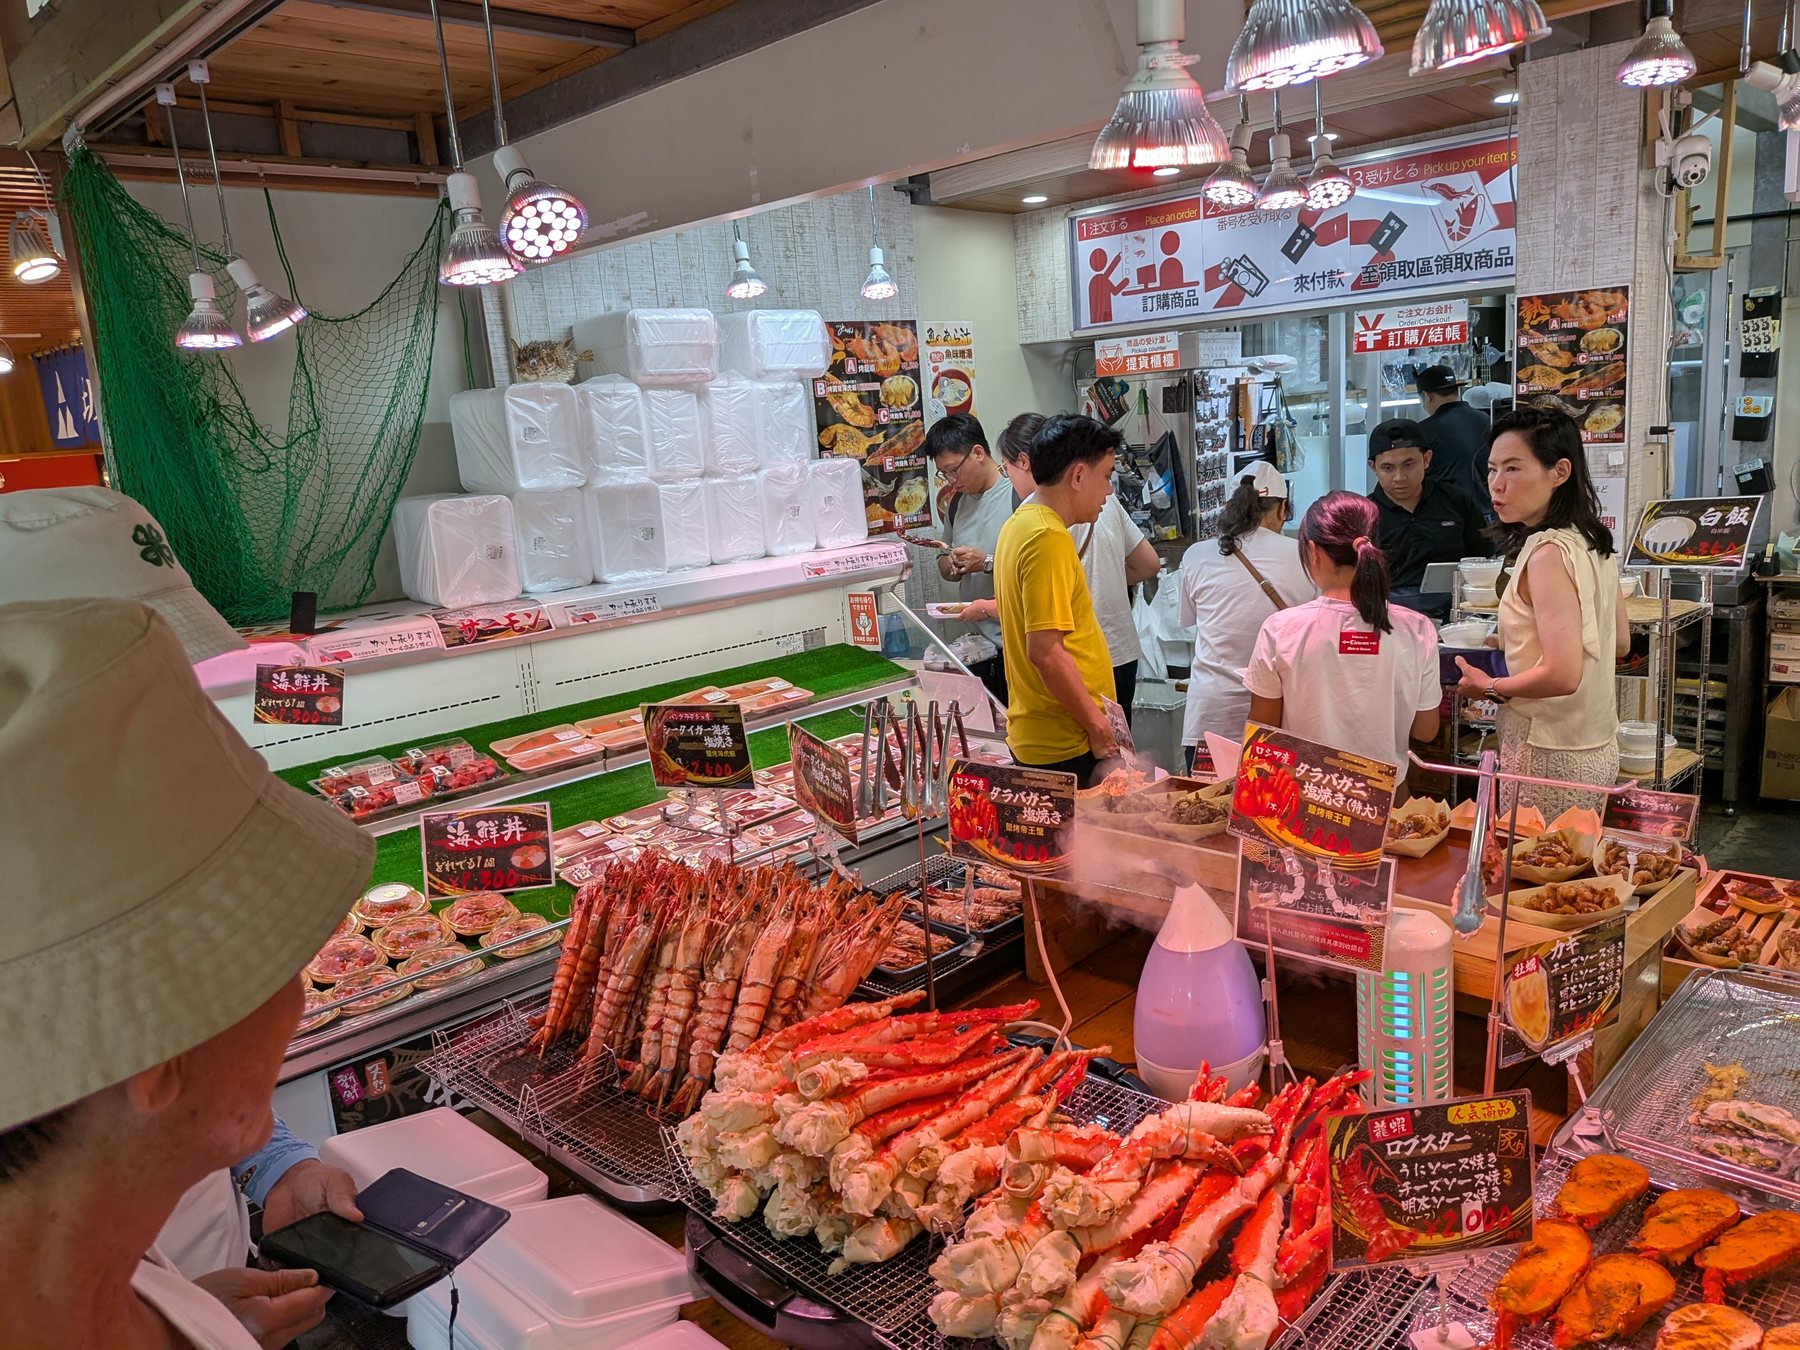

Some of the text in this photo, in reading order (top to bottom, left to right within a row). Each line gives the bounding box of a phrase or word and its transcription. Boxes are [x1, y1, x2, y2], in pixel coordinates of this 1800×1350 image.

[1424, 162, 1443, 175] Pick
[1444, 160, 1459, 171] up
[1462, 155, 1485, 170] your
[1145, 208, 1198, 226] Place an order
[1217, 209, 1292, 232] 番号を受け取る
[1361, 246, 1514, 285] 至領取區領取商品
[1294, 269, 1345, 293] 來付款
[1142, 289, 1200, 313] 訂購商品
[1126, 336, 1172, 347] 商品の受け渡し
[1388, 325, 1461, 347] 訂購/結帳
[1579, 354, 1587, 363] C
[1520, 384, 1527, 393] D
[1579, 389, 1587, 398] E
[1699, 506, 1750, 526] 白飯
[457, 609, 541, 643] サーモン
[272, 671, 330, 693] 海鮮丼
[663, 724, 731, 736] シータイガー海老
[704, 736, 733, 748] 塩焼き
[1255, 745, 1292, 766] ロシア産
[956, 777, 985, 791] ロシア産
[1295, 762, 1368, 798] タラバガニ
[990, 786, 1054, 808] タラバガニ
[1302, 782, 1379, 820] 塩焼き(特大)
[1022, 807, 1062, 825] 塩焼き
[446, 816, 527, 848] 海鮮丼
[1550, 937, 1579, 960] カキ
[1561, 955, 1622, 983] うにソース焼き
[1452, 1102, 1512, 1122] 人気商品
[1386, 1132, 1472, 1157] ロブスター
[1399, 1152, 1498, 1178] うにソース焼き
[1399, 1168, 1513, 1197] チーズソース焼き
[1401, 1187, 1501, 1214] 明太ソース焼き
